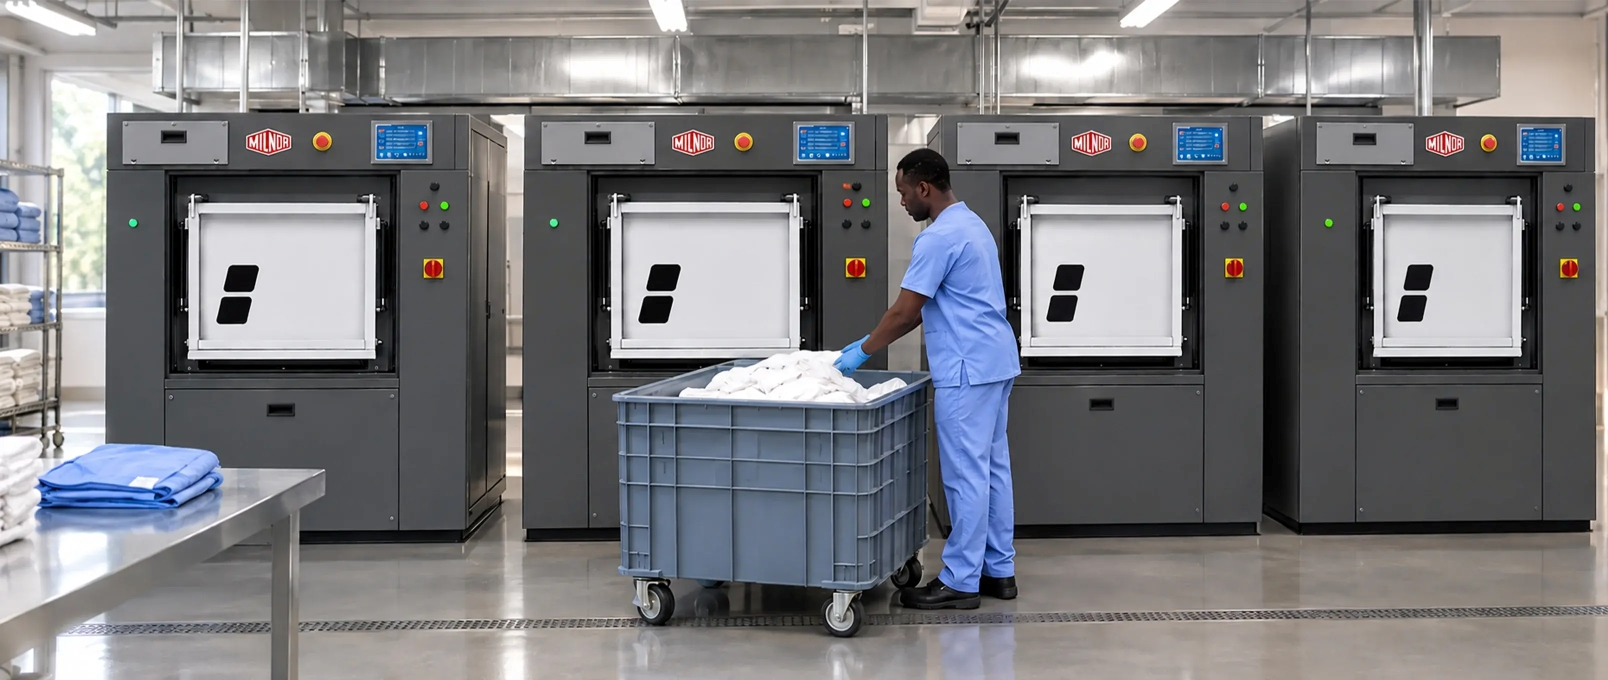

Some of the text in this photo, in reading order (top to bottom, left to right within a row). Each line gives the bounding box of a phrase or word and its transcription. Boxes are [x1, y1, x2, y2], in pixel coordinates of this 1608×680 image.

[249, 132, 289, 152] MILNOR
[674, 132, 712, 152] MILNOR
[1074, 133, 1109, 153] MILNOR
[1428, 134, 1462, 154] MILNOR
